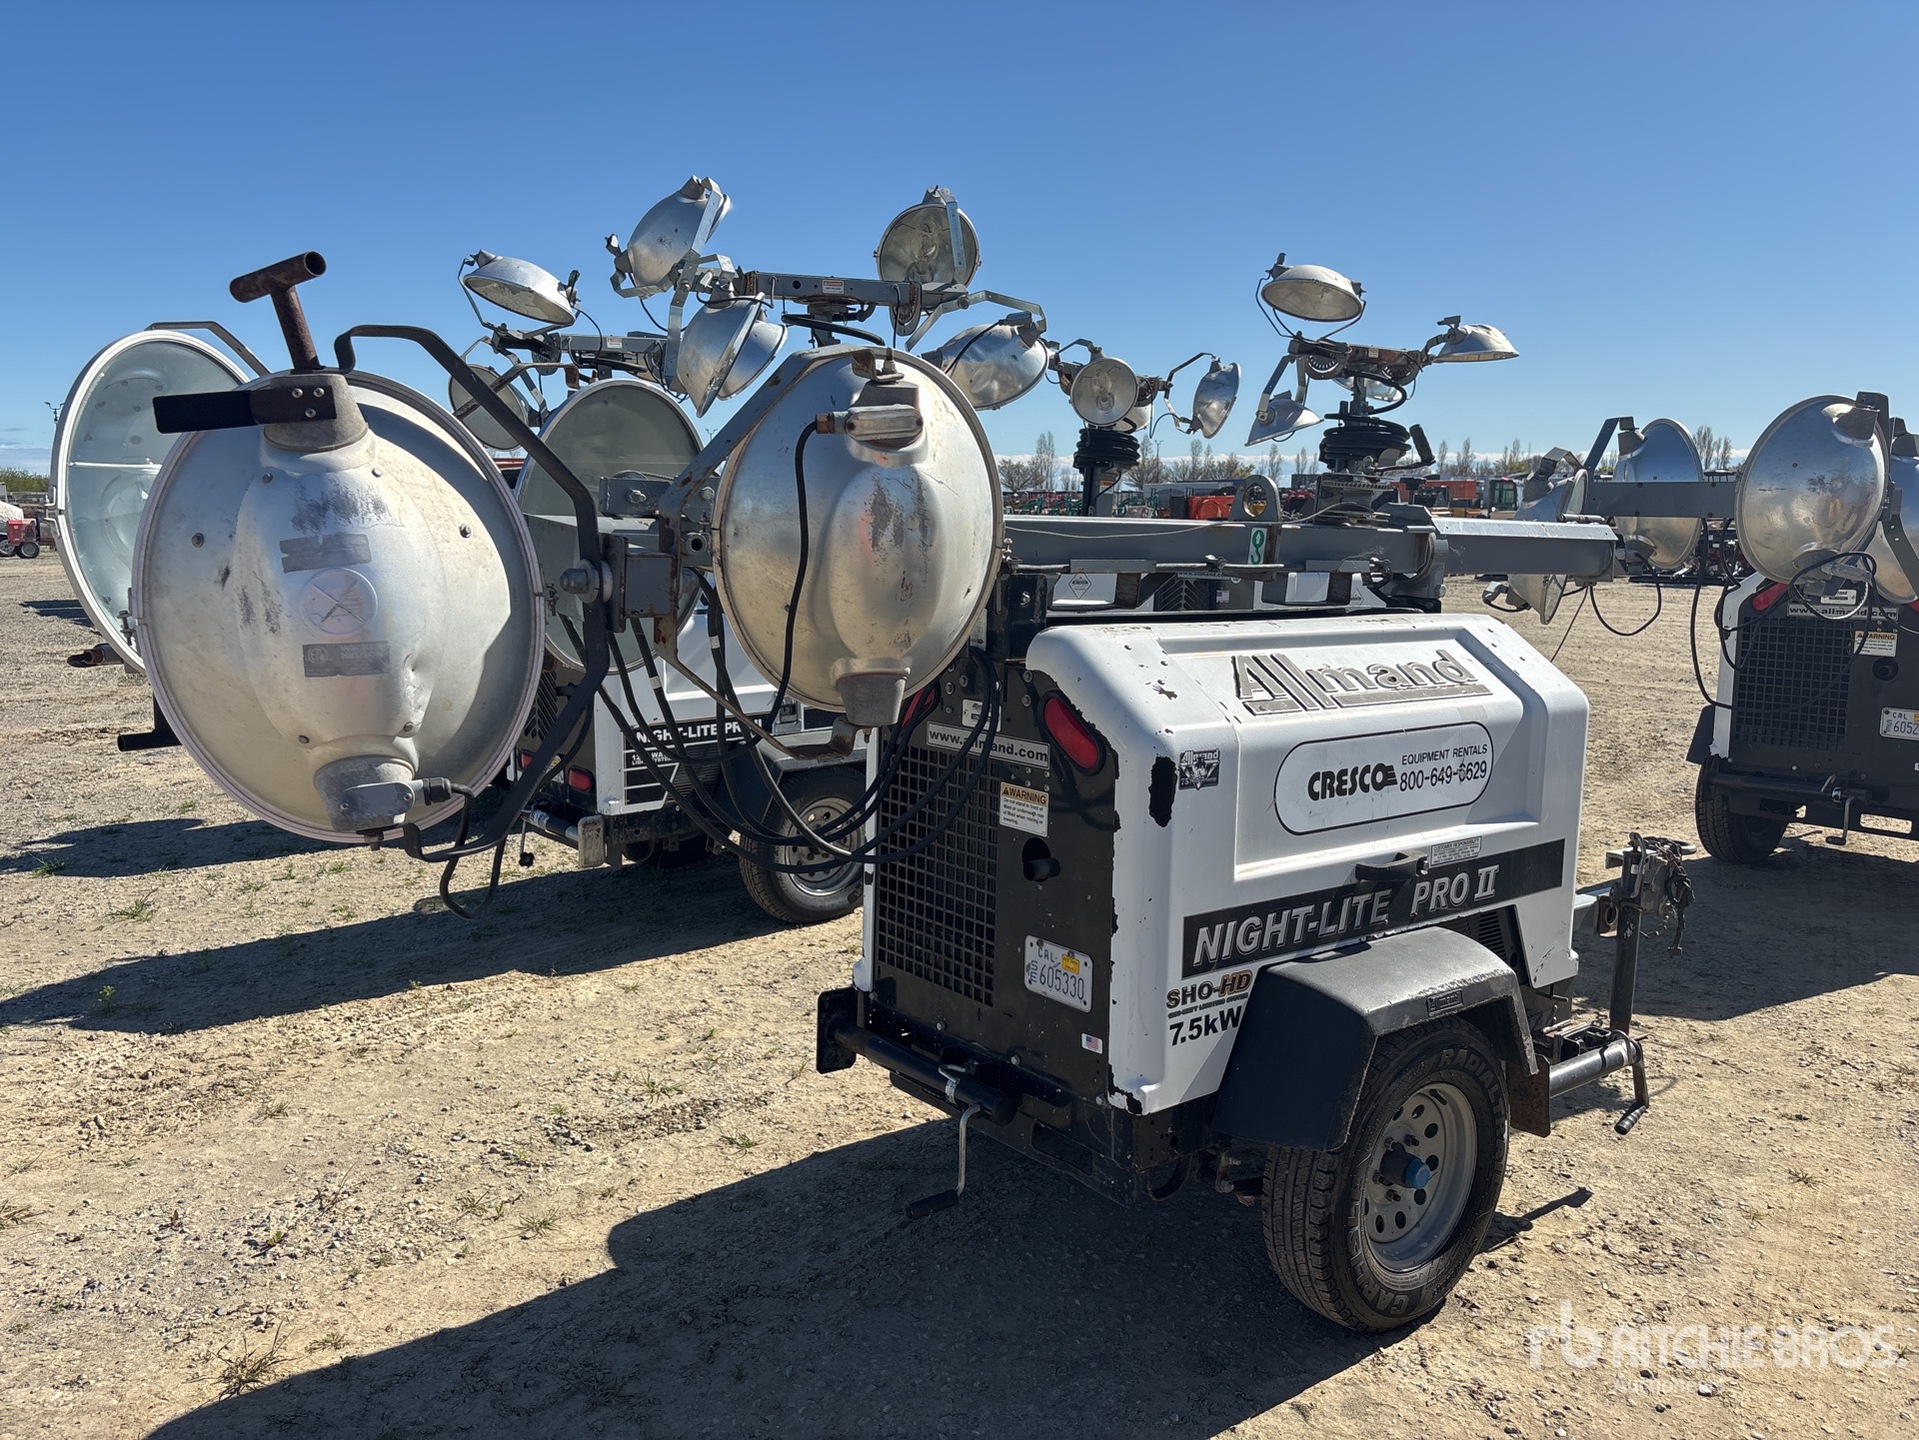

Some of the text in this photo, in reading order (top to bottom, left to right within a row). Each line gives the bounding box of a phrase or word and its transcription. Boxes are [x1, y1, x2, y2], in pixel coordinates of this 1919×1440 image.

[1864, 632, 1895, 641] ARNING
[1231, 650, 1478, 711] Allmand
[636, 723, 717, 744] NGH-LITE
[725, 720, 752, 734] PR
[1892, 712, 1907, 720] CAL
[929, 730, 1047, 762] www.land.com
[1401, 743, 1488, 766] EQUIPMENT RENTALS
[1307, 763, 1397, 801] CRESCO
[1400, 760, 1487, 792] 800-649-6629
[1009, 787, 1046, 805] WARNING
[1192, 865, 1500, 968] NIGHT-LITE PRO II
[1037, 946, 1055, 963] CAL
[1039, 964, 1085, 1000] 605330
[1166, 969, 1253, 1009] SHO-HD
[1169, 1005, 1242, 1046] 7.5kW
